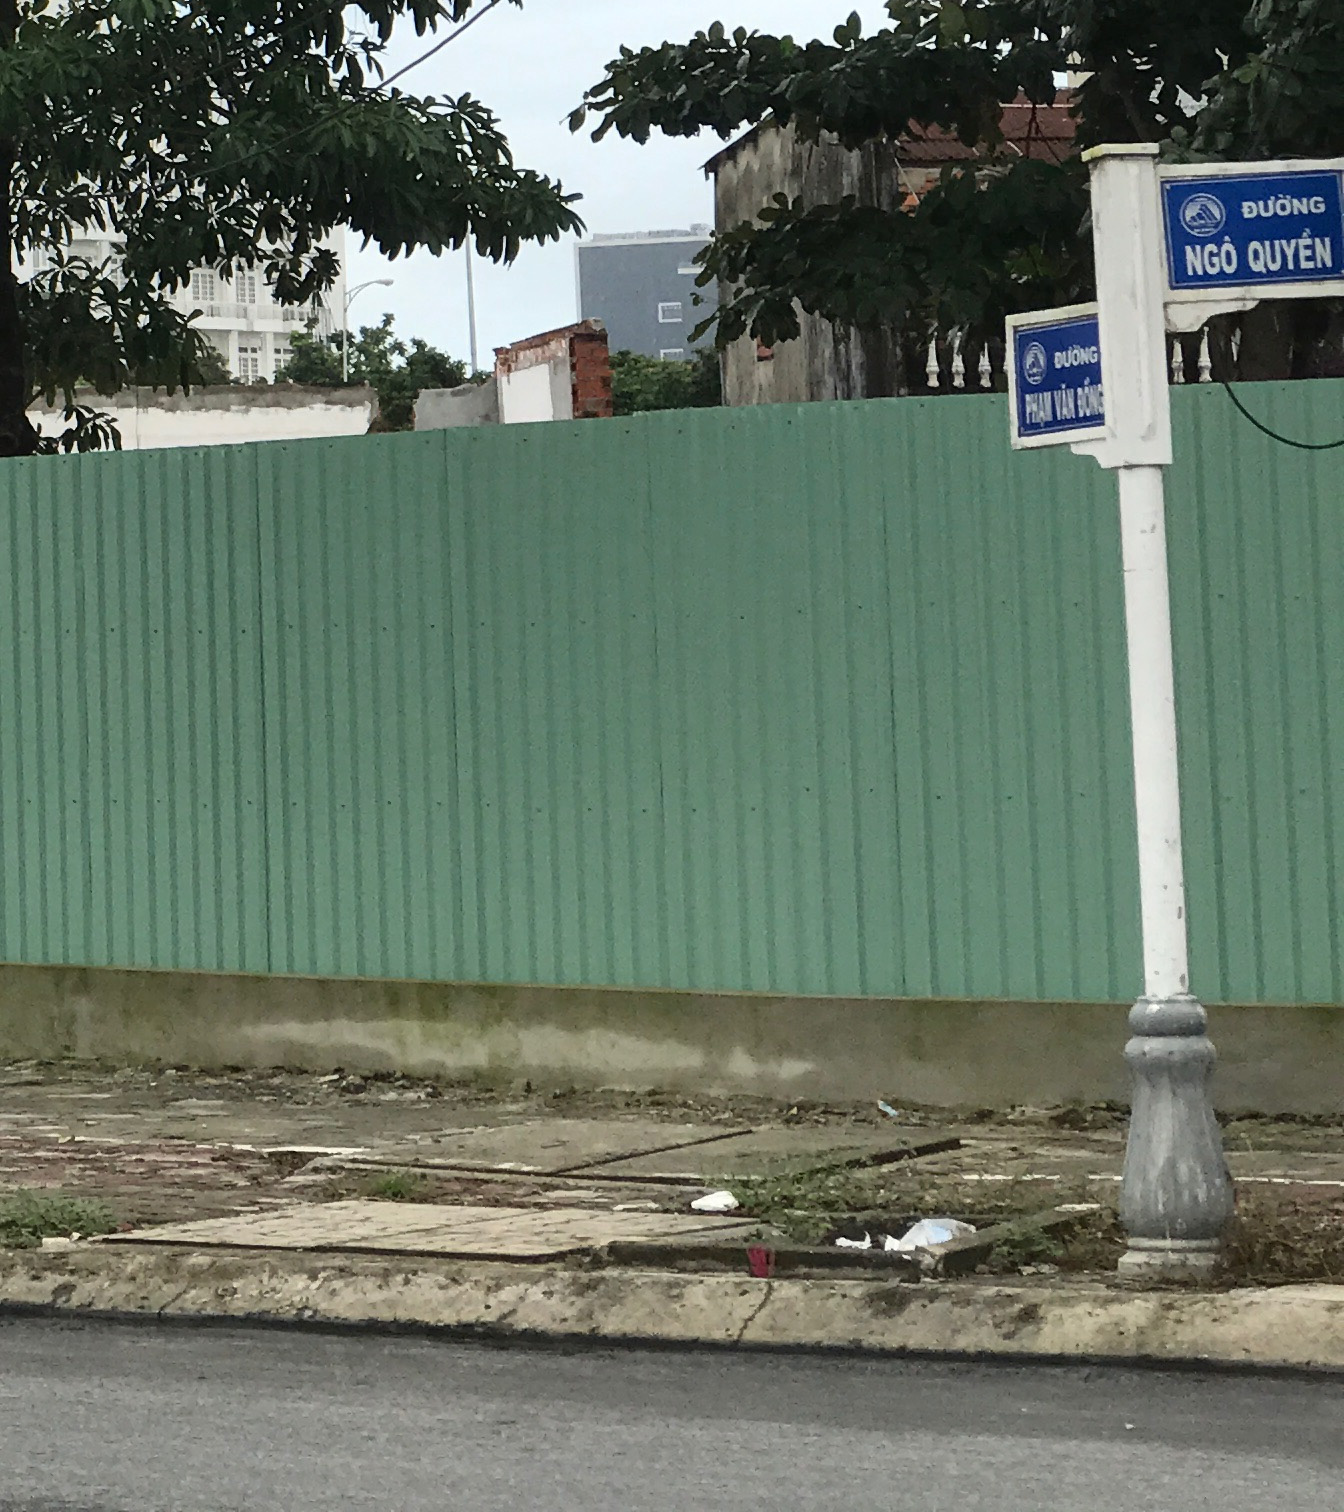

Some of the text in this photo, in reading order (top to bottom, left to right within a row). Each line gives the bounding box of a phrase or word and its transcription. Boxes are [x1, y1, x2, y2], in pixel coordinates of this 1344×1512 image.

[1241, 194, 1326, 219] ĐƯỜNG
[1184, 228, 1333, 276] NGÔ QUYỀN
[1054, 344, 1098, 369] ĐƯỜNG
[1025, 391, 1053, 427] PHẠM
[1053, 383, 1076, 421] VĂN
